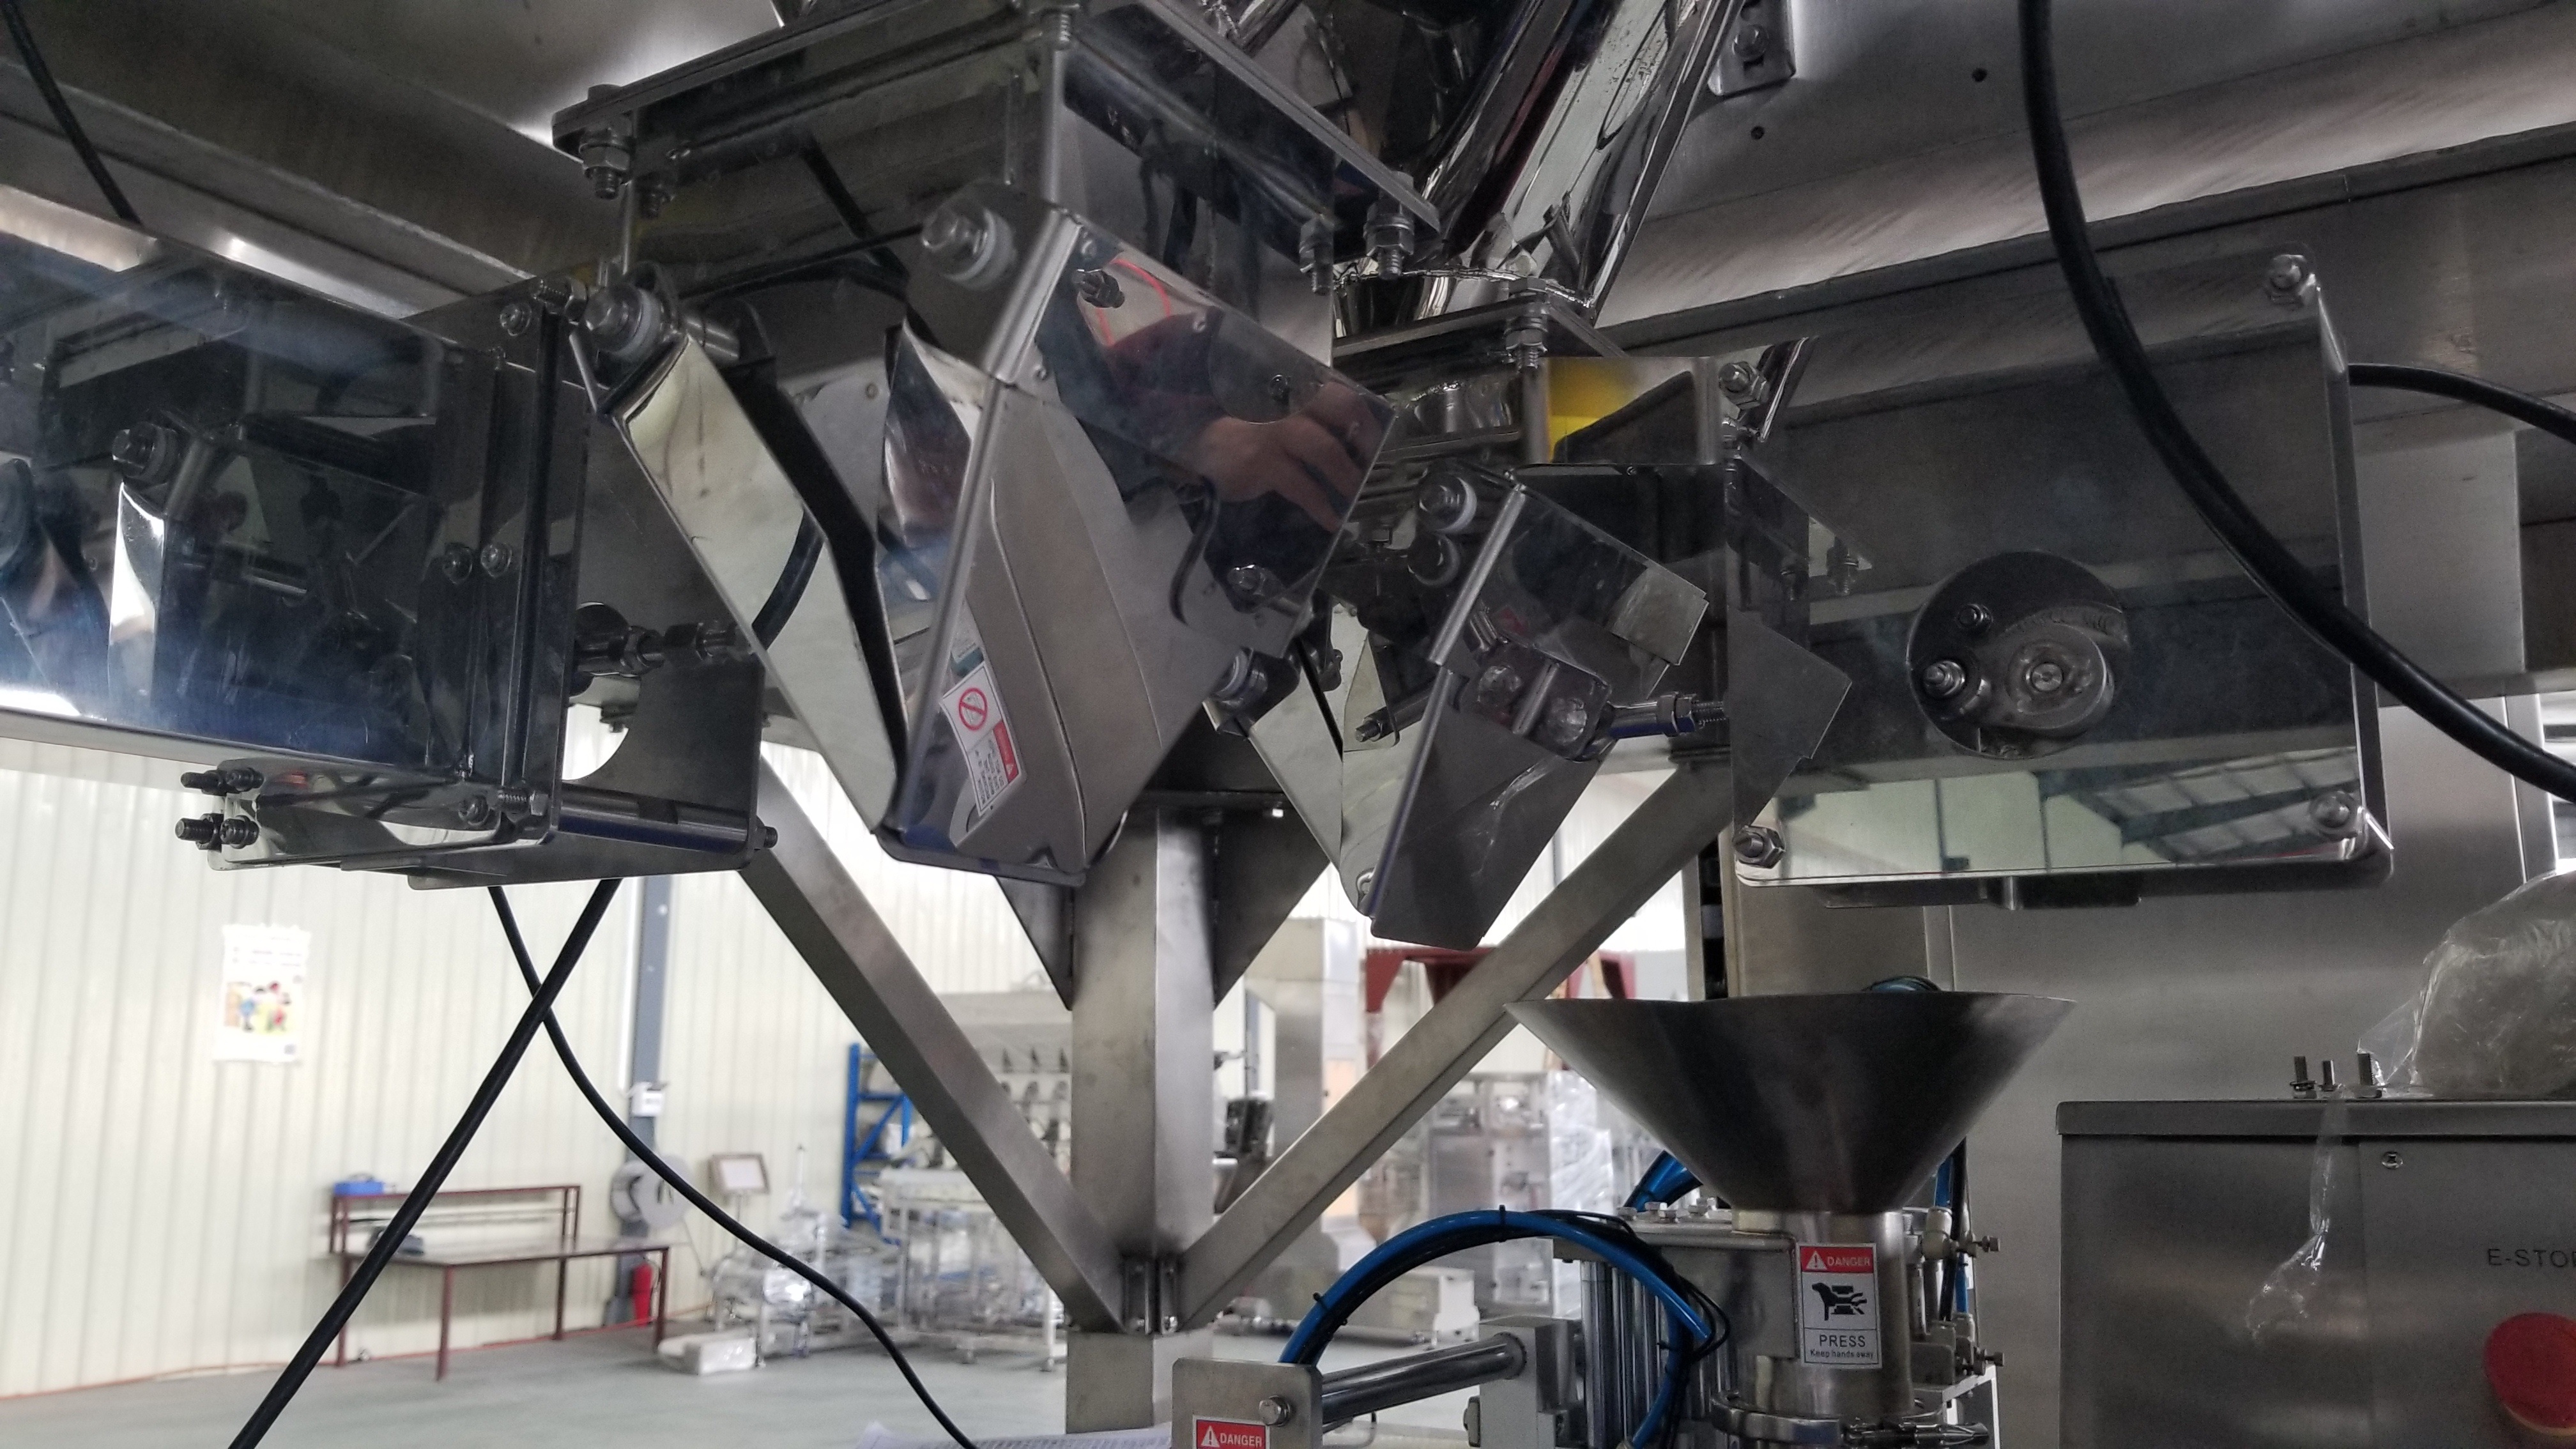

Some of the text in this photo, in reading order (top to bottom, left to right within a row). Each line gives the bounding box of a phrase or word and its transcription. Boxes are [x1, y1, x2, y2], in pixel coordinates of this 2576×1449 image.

[1827, 1256, 1871, 1266] DANGER
[2488, 1248, 2576, 1268] E-STO
[1819, 1334, 1866, 1347] PRESS
[1810, 1349, 1830, 1358] Keep
[1220, 1432, 1263, 1448] DANGER
